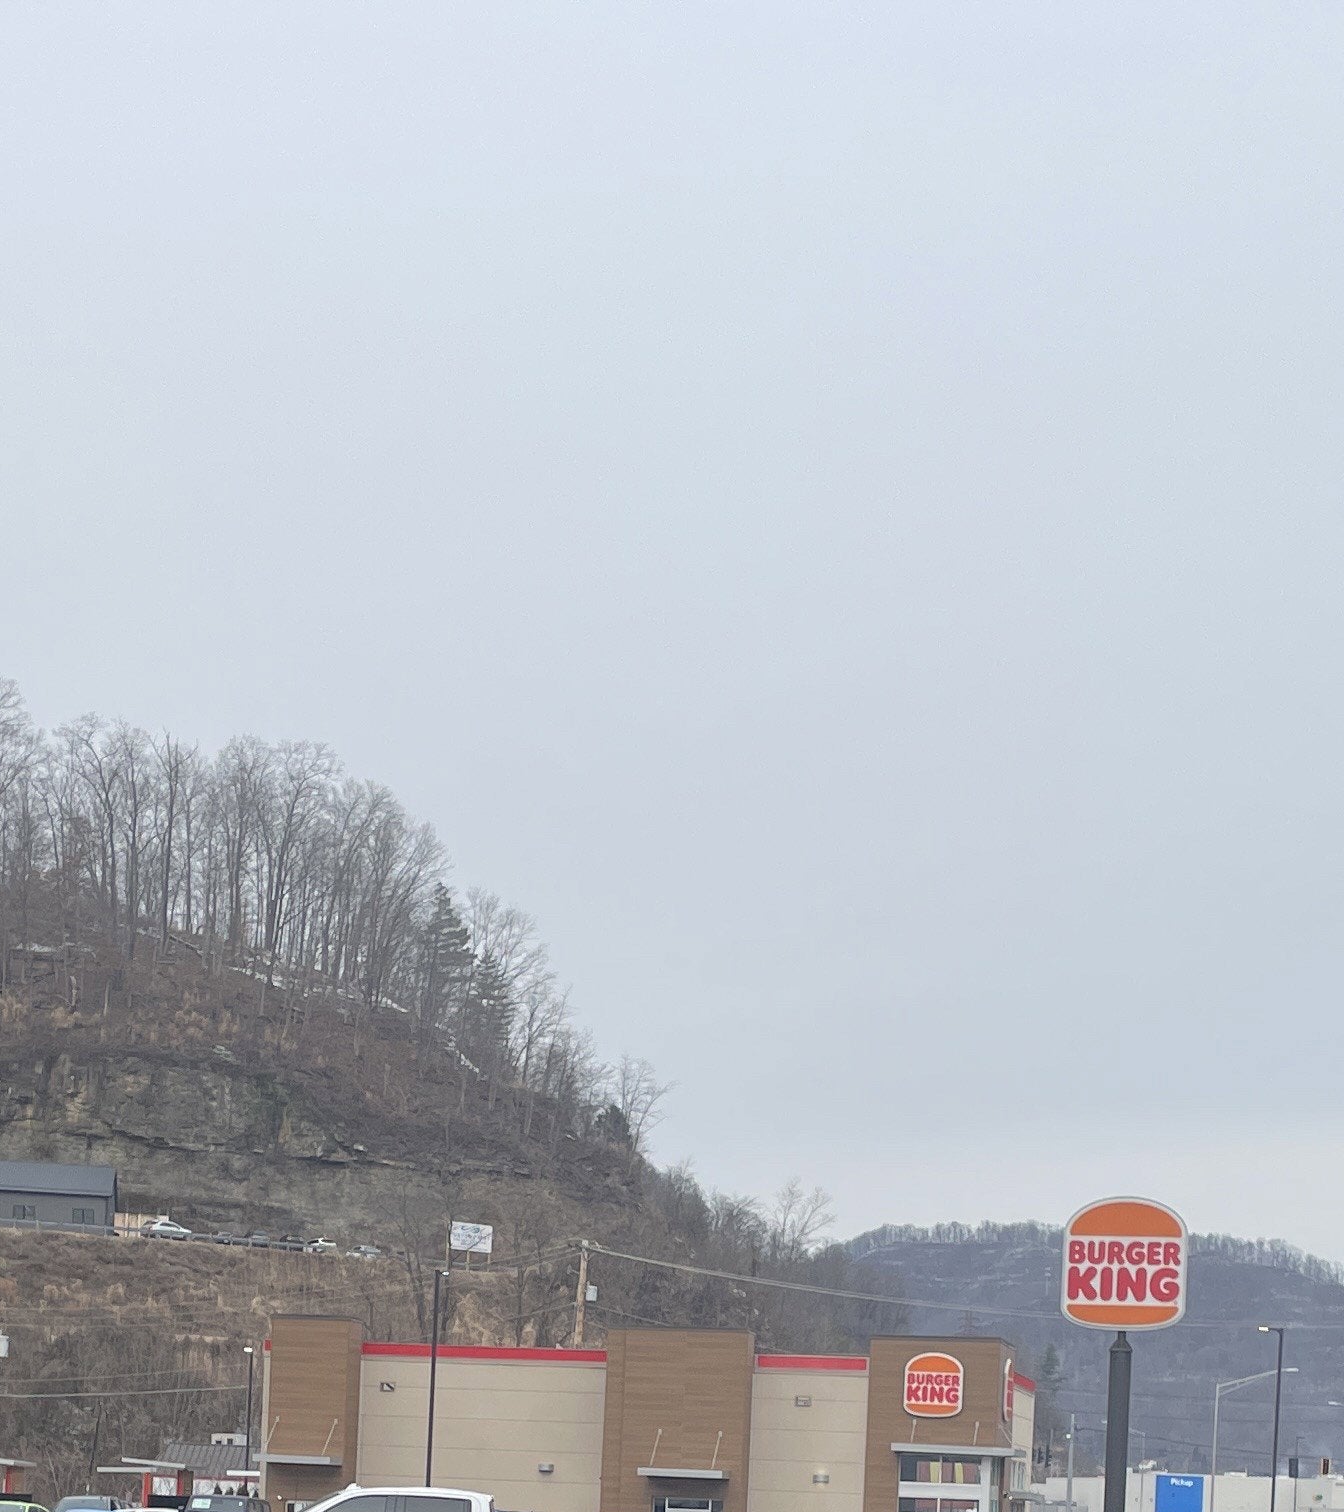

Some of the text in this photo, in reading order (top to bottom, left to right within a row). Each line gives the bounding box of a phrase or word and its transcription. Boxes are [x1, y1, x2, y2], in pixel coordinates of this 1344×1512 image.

[1068, 1240, 1181, 1266] BURGER
[1067, 1266, 1180, 1302] KING
[907, 1373, 960, 1387] BURGER
[906, 1386, 960, 1404] KING
[1170, 1477, 1194, 1488] Pickup
